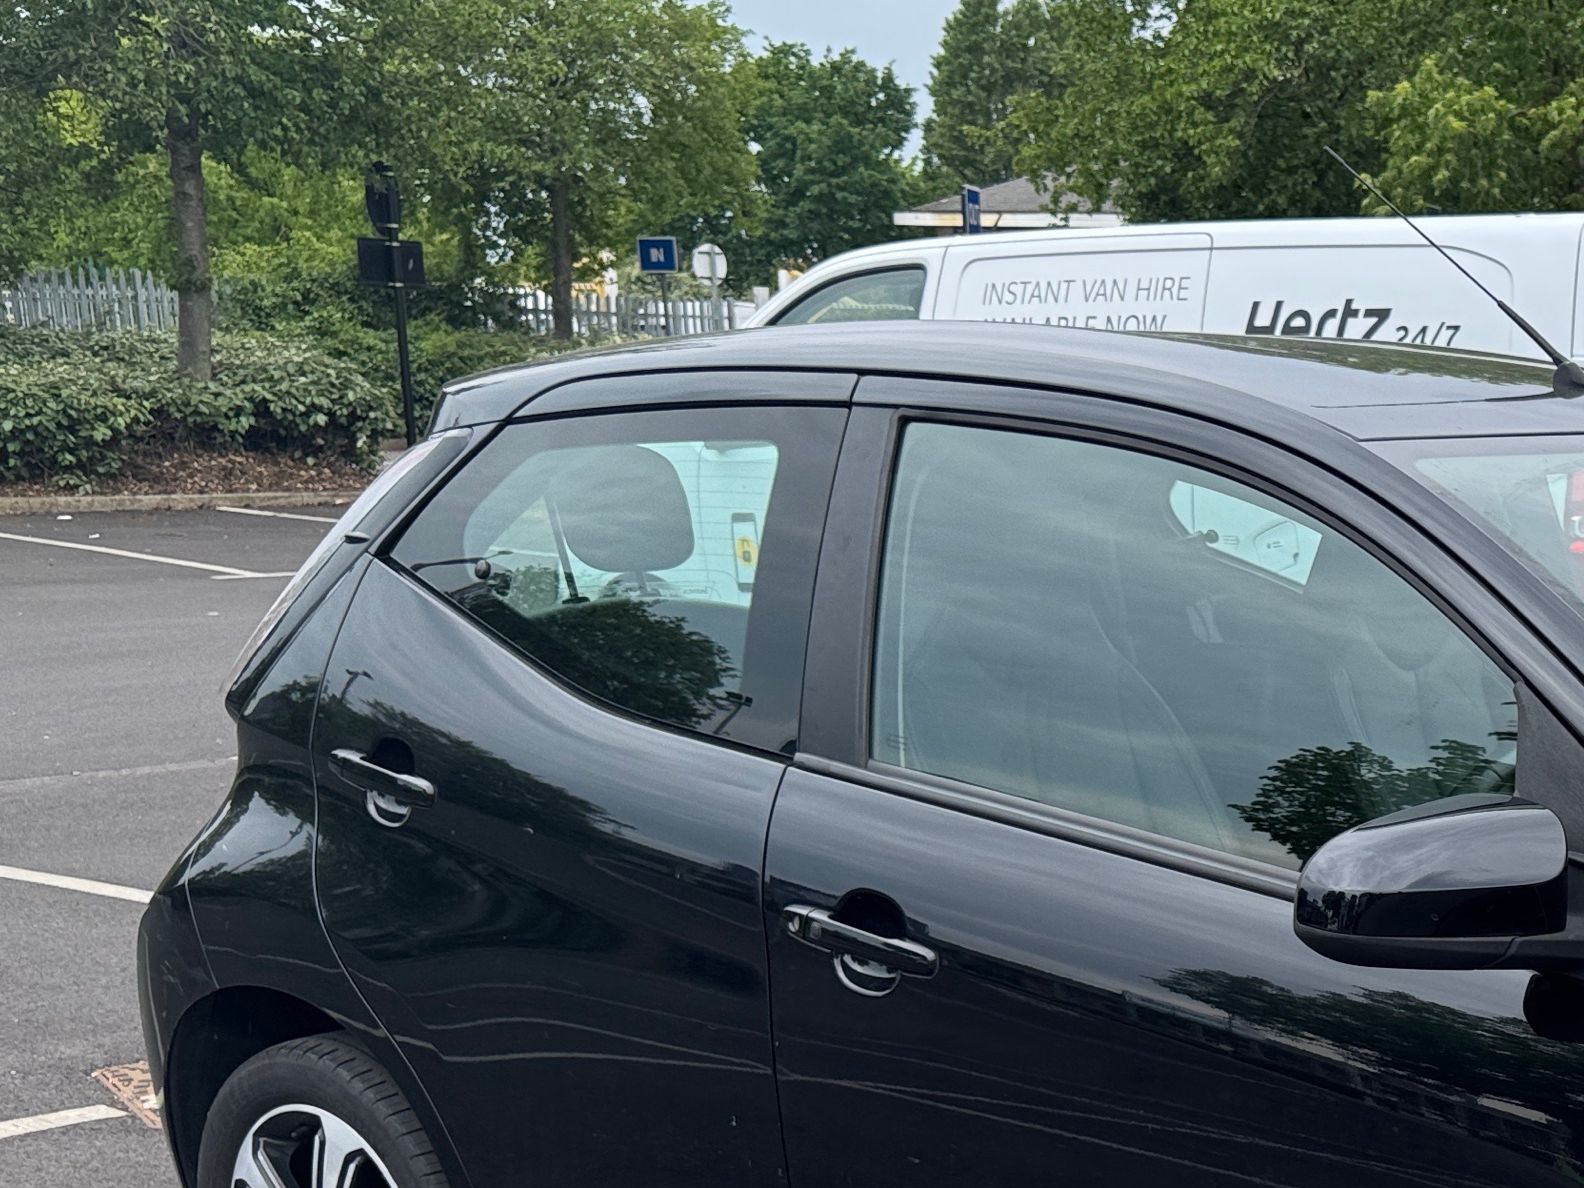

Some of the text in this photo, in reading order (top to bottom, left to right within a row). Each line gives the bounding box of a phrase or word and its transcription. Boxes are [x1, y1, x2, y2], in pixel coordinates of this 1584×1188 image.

[982, 276, 1191, 306] INSTANT VAN HIRE
